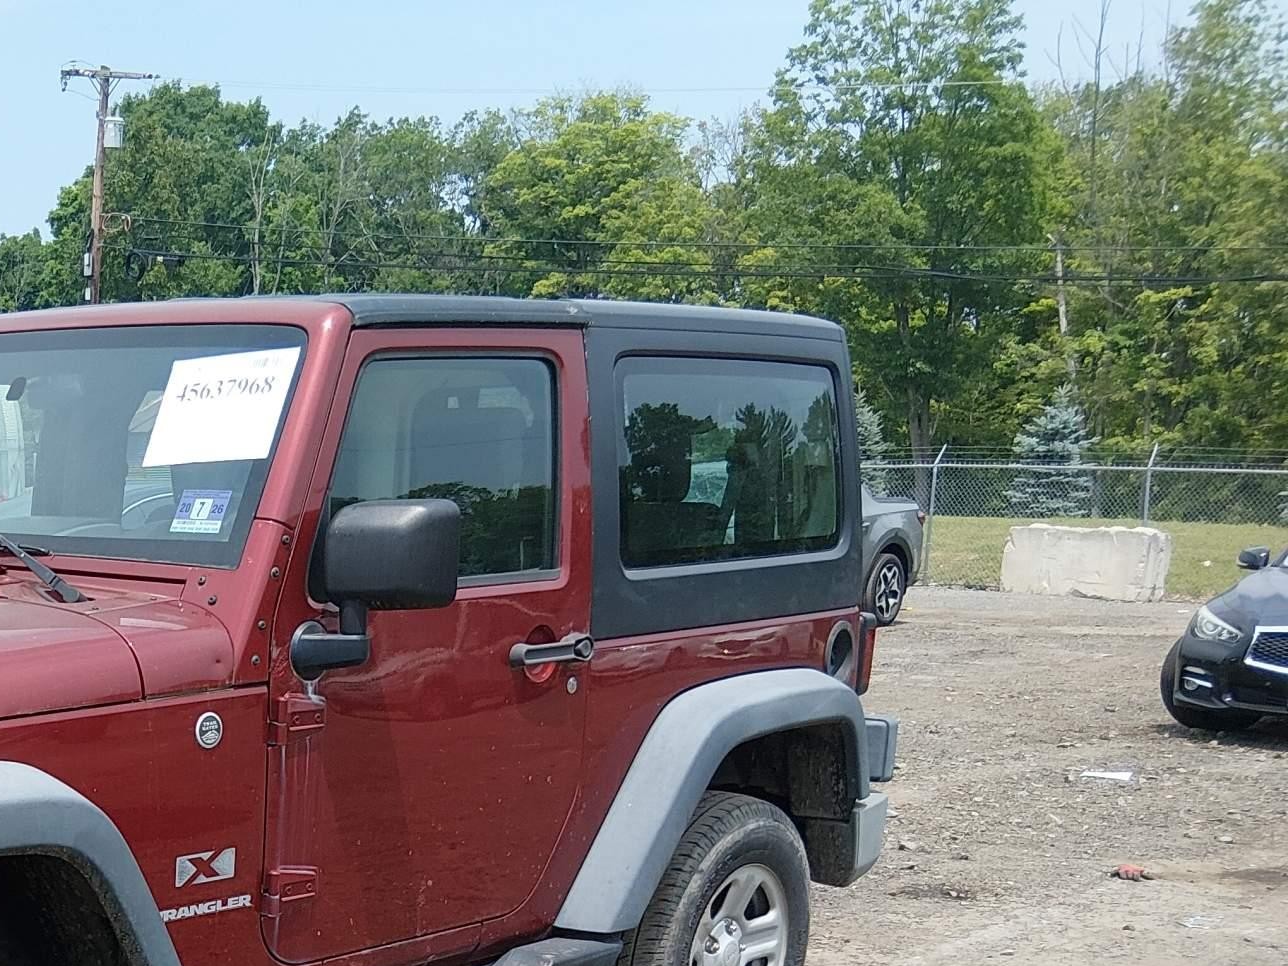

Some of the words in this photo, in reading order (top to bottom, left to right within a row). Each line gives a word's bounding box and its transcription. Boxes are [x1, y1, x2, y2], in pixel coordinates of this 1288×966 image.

[176, 375, 275, 403] 45637968
[179, 502, 192, 513] 20
[196, 501, 206, 518] 7
[210, 504, 225, 514] 26
